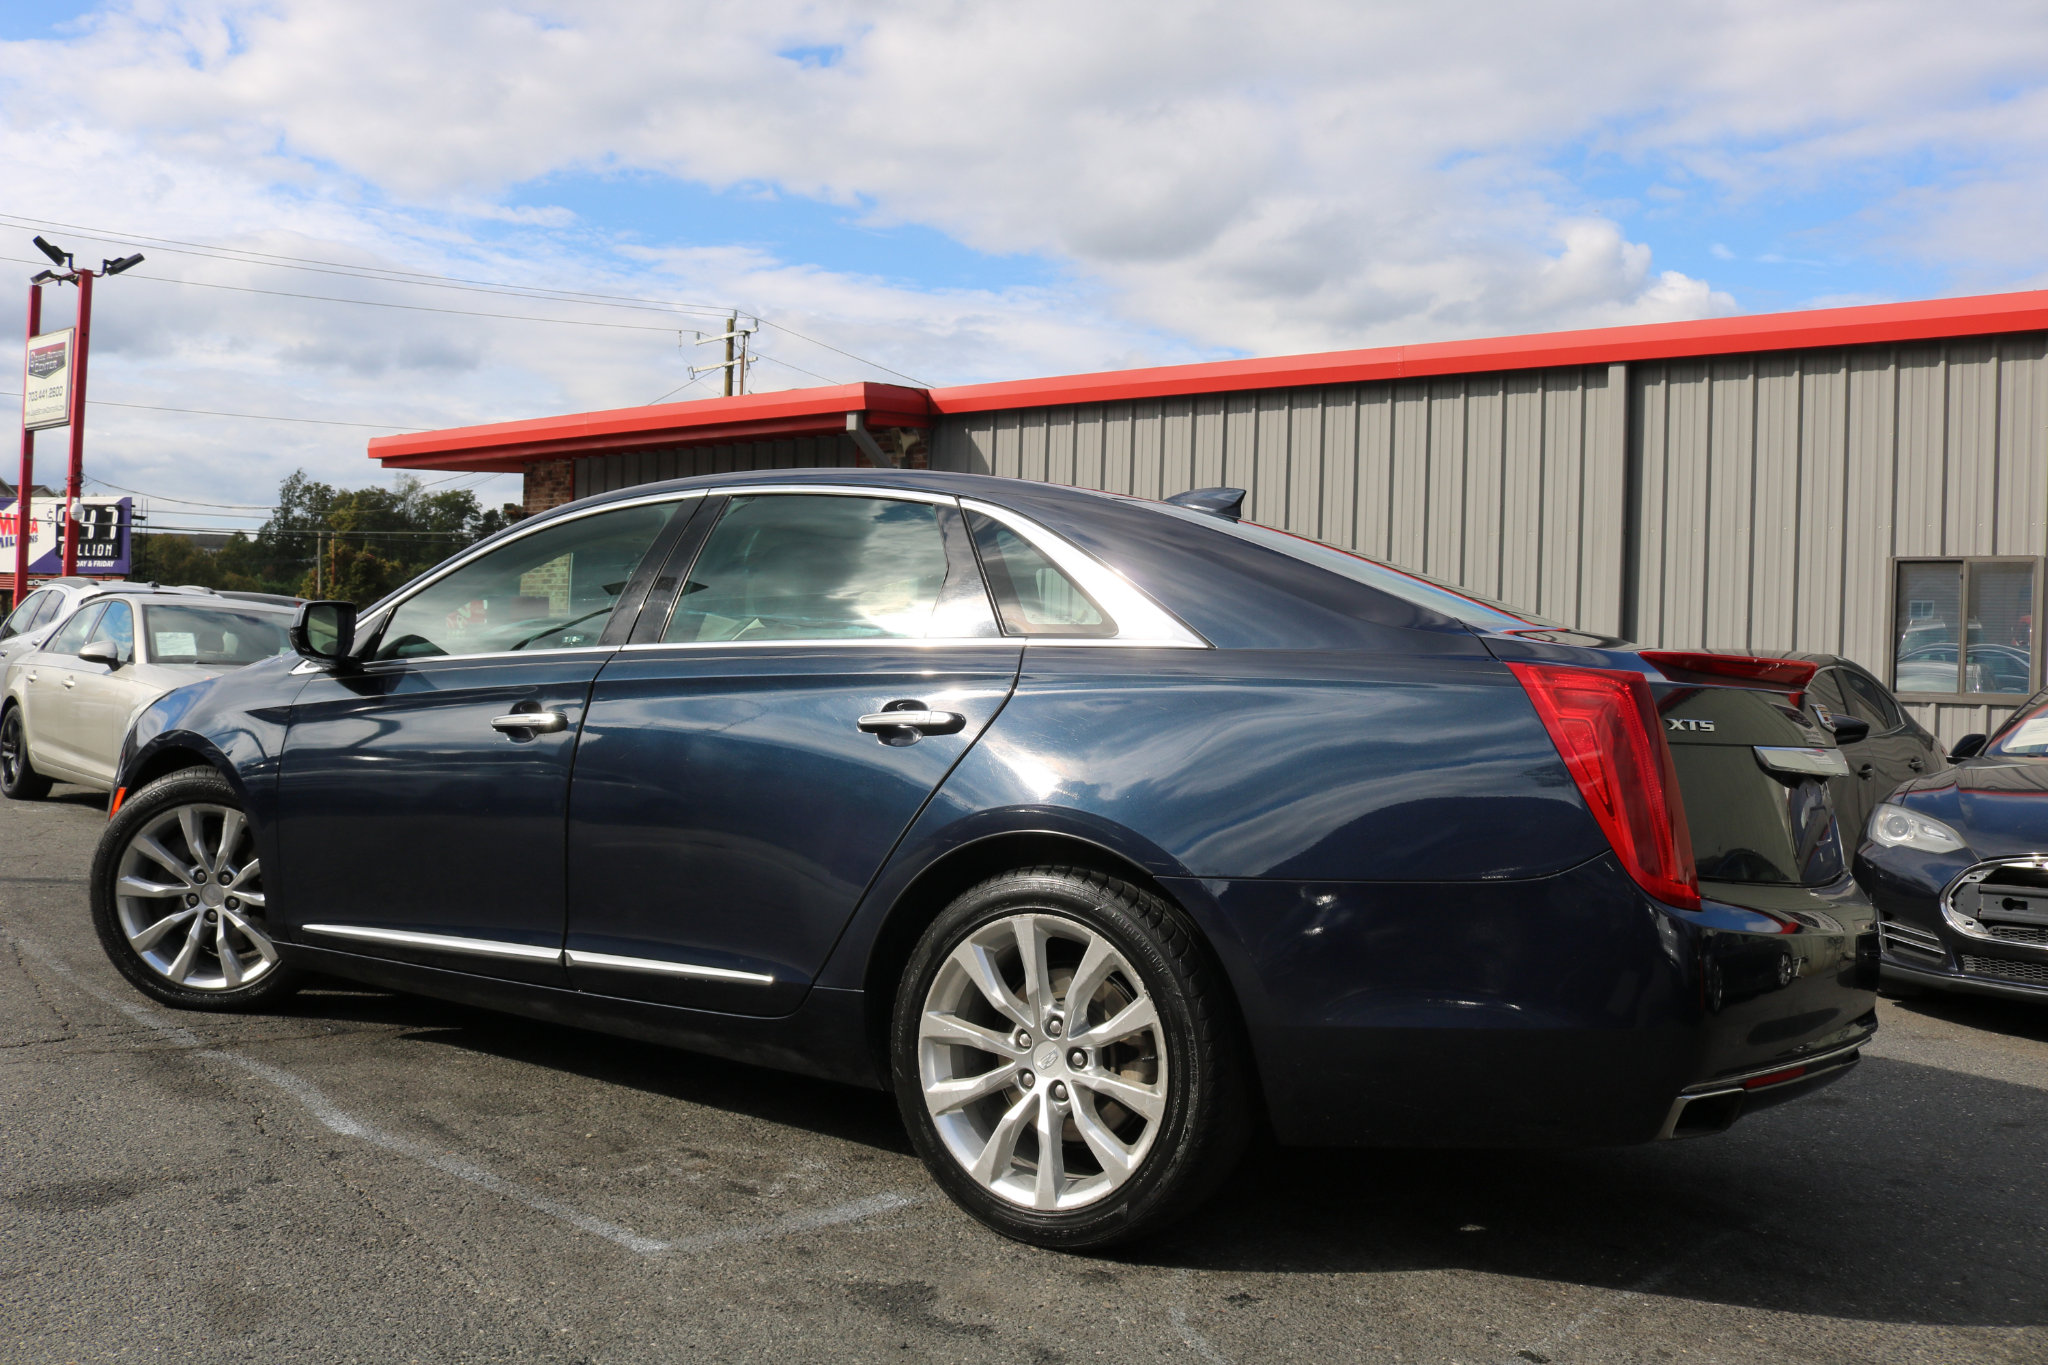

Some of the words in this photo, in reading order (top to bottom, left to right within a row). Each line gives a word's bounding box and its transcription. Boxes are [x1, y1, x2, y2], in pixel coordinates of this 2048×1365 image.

[60, 544, 112, 557] LLION
[93, 560, 114, 568] FRIDAY
[1665, 718, 1715, 732] XTS
